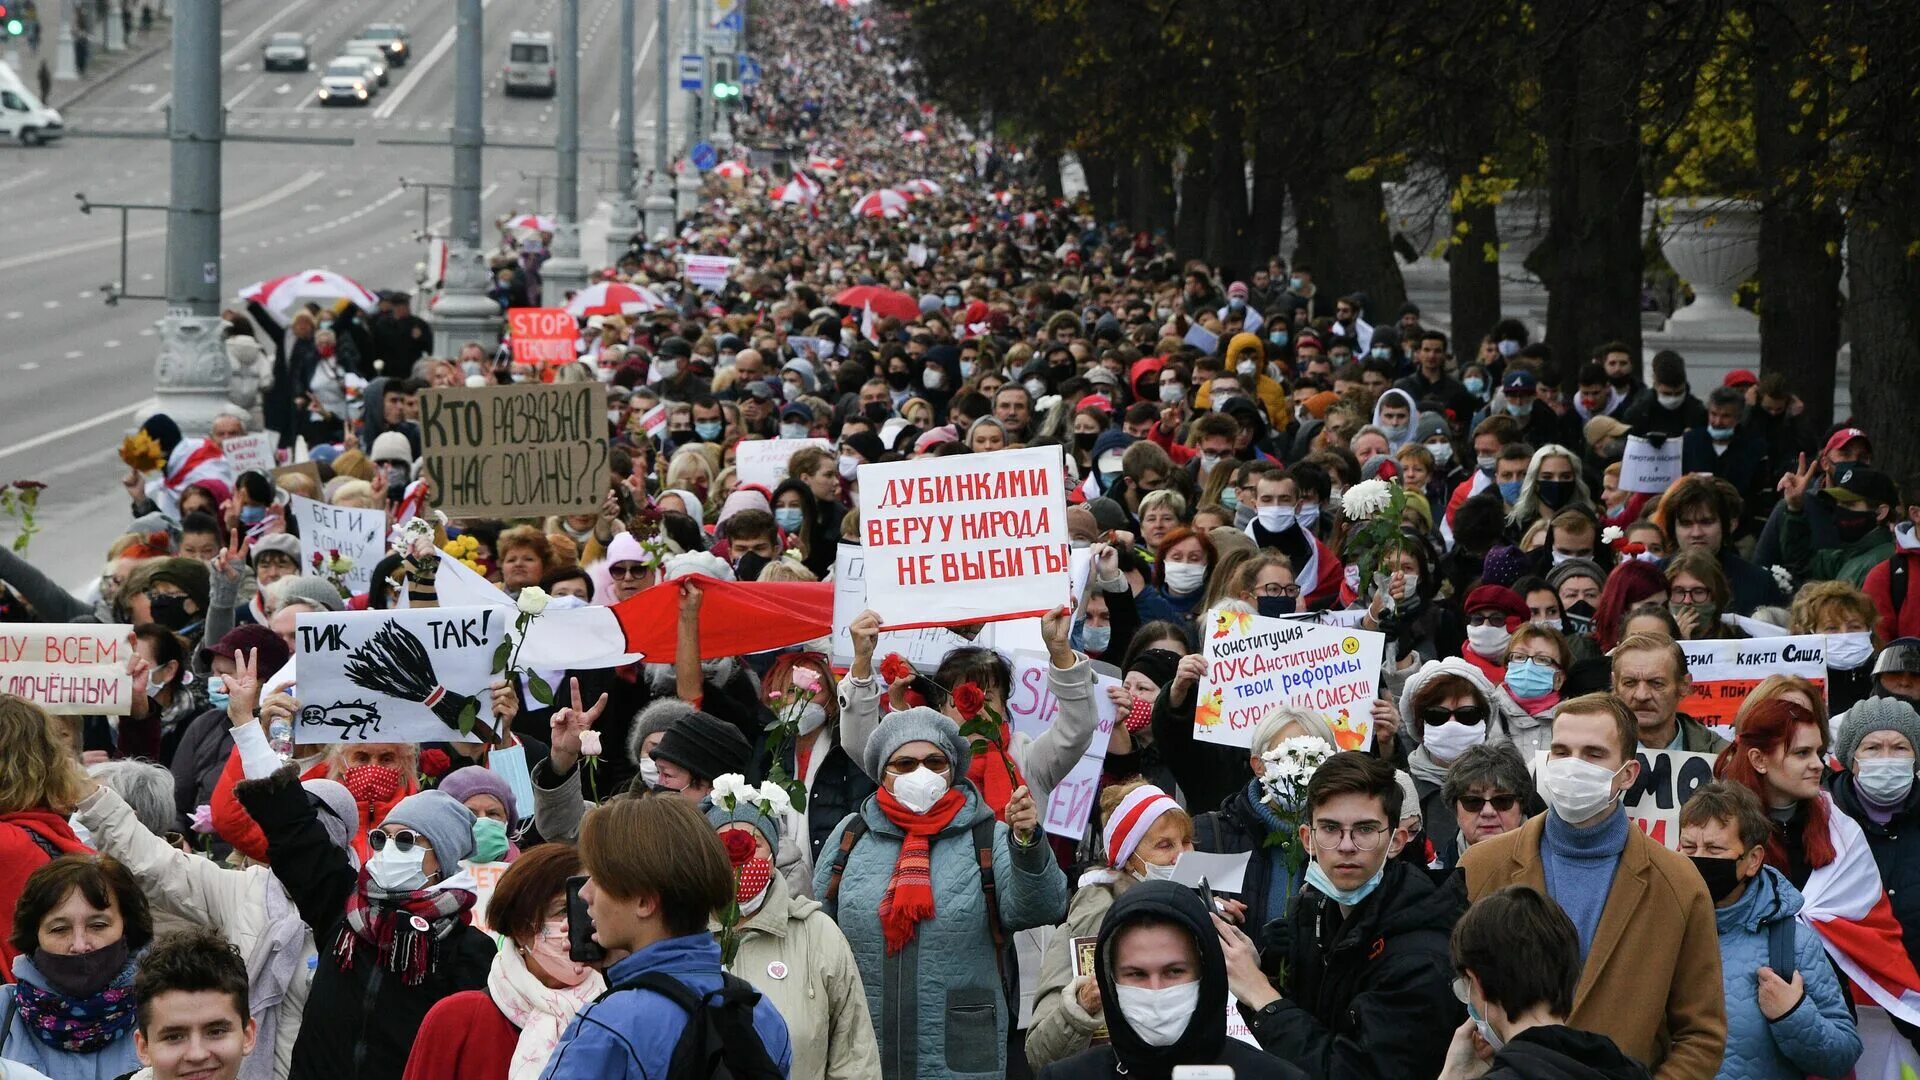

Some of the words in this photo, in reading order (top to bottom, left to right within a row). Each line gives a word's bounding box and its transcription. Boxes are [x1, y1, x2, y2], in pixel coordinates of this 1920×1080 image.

[514, 313, 570, 335] STOP
[420, 395, 483, 447] КТО
[493, 388, 592, 445] РАЗВЯЗАЛ
[427, 455, 445, 508] У
[452, 454, 493, 506] НАС
[502, 438, 608, 506] ВОЙНУ??
[878, 468, 1049, 509] ДУБИНКАМИ
[312, 503, 363, 532] БЕГИ
[867, 515, 934, 547] ВЕРУ
[938, 515, 954, 542] У
[961, 507, 1050, 541] НАРОДА
[897, 555, 936, 586] НЕ
[941, 543, 1068, 583] ВЫБИТЬ!
[45, 636, 117, 664] ВСЕМ
[298, 624, 350, 653] ТИК
[427, 609, 493, 650] ТАК!
[1282, 658, 1362, 695] реформы
[1685, 653, 1714, 666] ЕРИЛ
[1736, 652, 1777, 665] КАК-ТО
[0, 673, 118, 704] ЛЮЧЁННЫМ
[1316, 680, 1371, 711] СМЕХ!!!
[1048, 777, 1093, 833] ЕЙ
